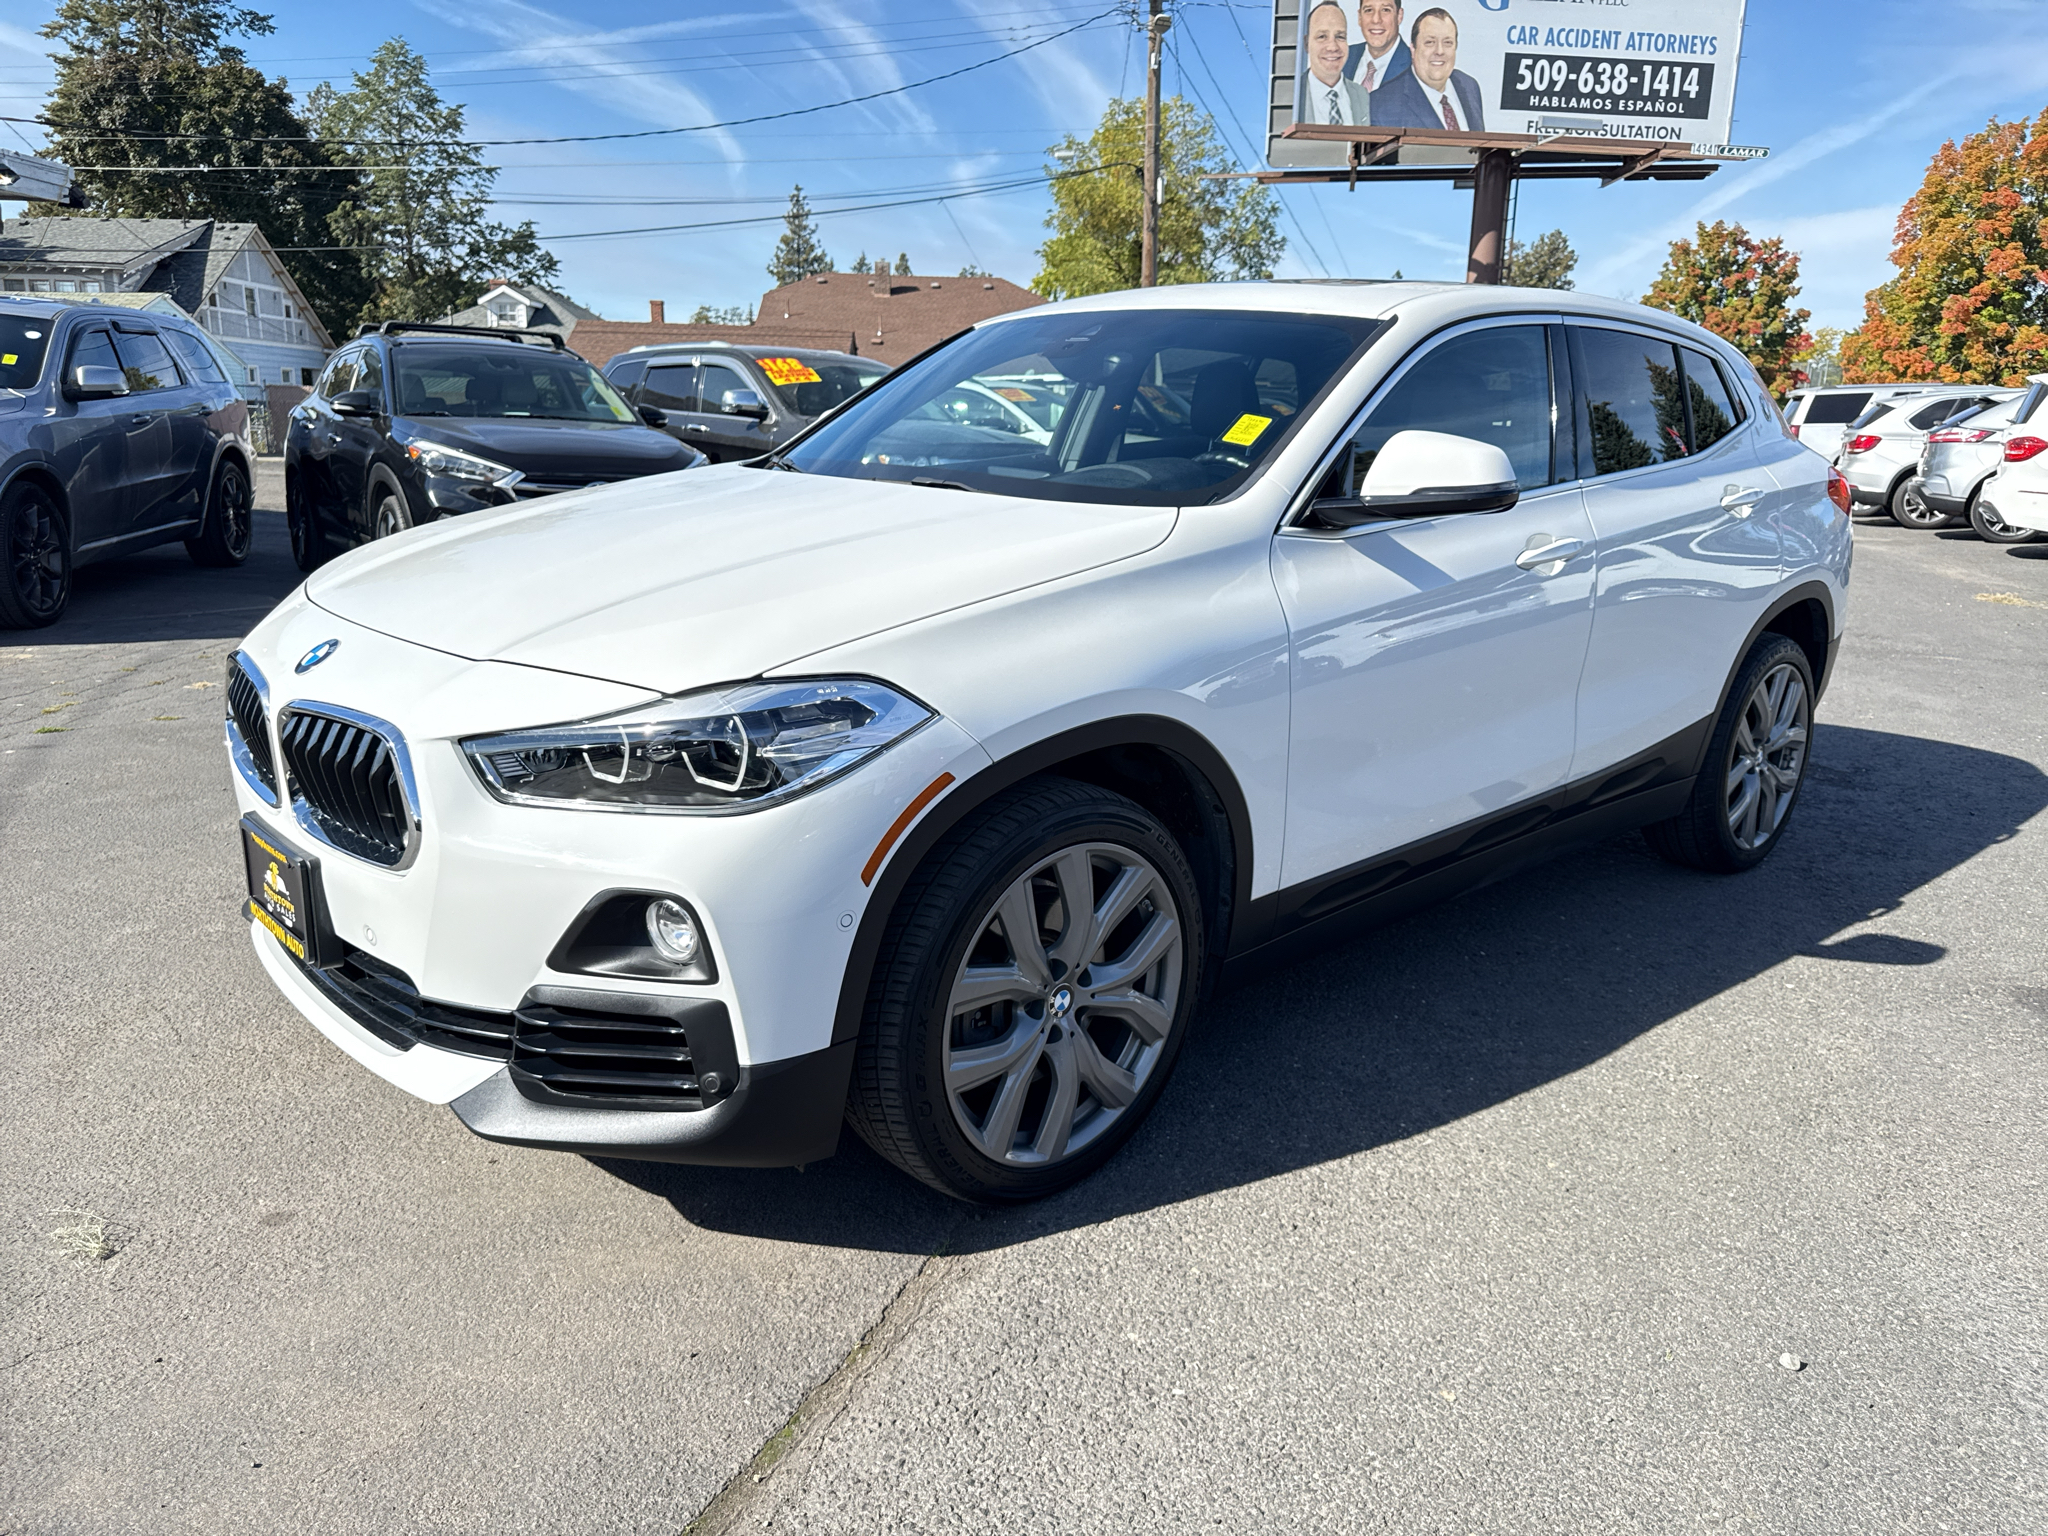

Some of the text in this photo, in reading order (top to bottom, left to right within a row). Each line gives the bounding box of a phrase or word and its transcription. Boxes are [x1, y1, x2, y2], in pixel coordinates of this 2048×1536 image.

[1506, 25, 1718, 55] CAR ACCIDENT ATTORNEYS
[1515, 58, 1699, 98] 509-638-1414
[1529, 95, 1685, 113] HABLAMOS ESPAÑOL
[1566, 122, 1682, 140] SULTATION
[1723, 147, 1765, 157] LAMAR
[1156, 833, 1197, 904] GENERAL
[276, 903, 296, 923] SALES
[285, 932, 305, 961] AUTO
